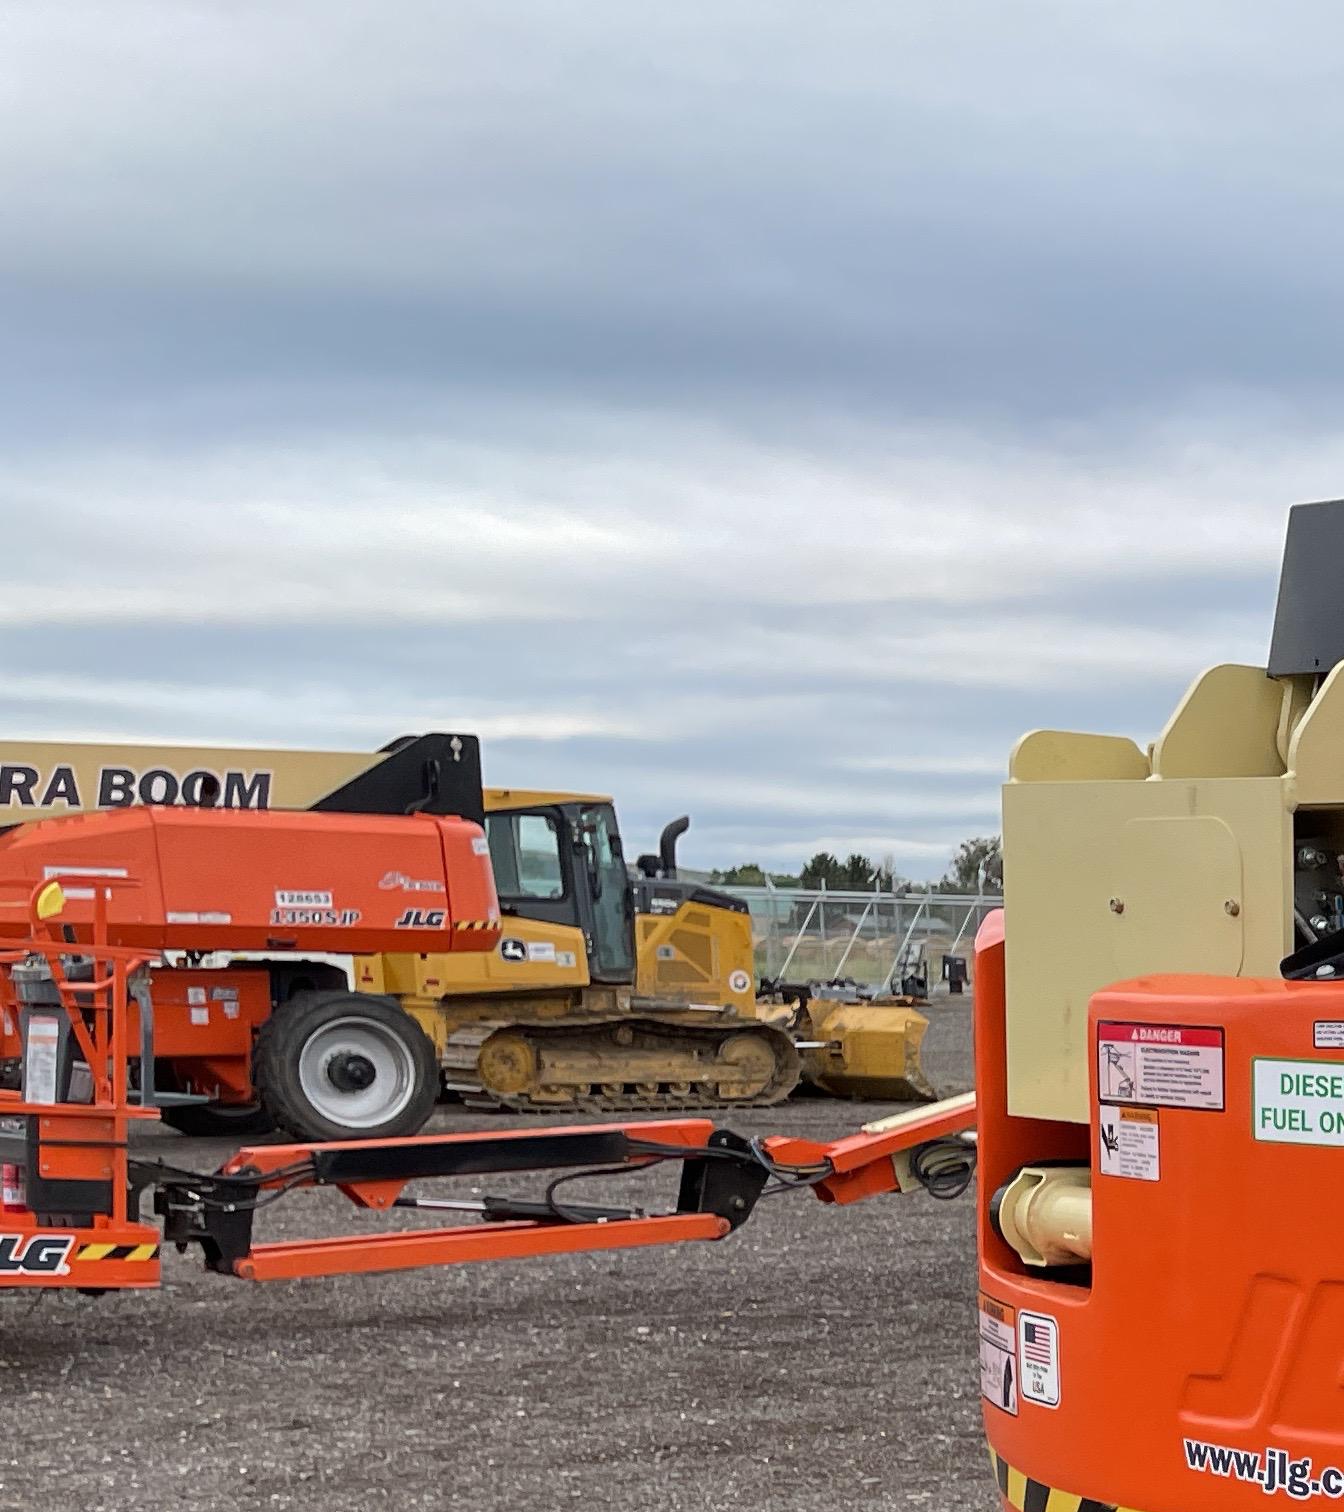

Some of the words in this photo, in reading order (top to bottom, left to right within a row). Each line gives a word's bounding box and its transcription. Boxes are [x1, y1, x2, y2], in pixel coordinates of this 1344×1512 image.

[98, 768, 271, 810] BOOM
[397, 911, 444, 926] JLG
[1139, 1029, 1182, 1043] DANGER
[1261, 1107, 1313, 1133] FUEL
